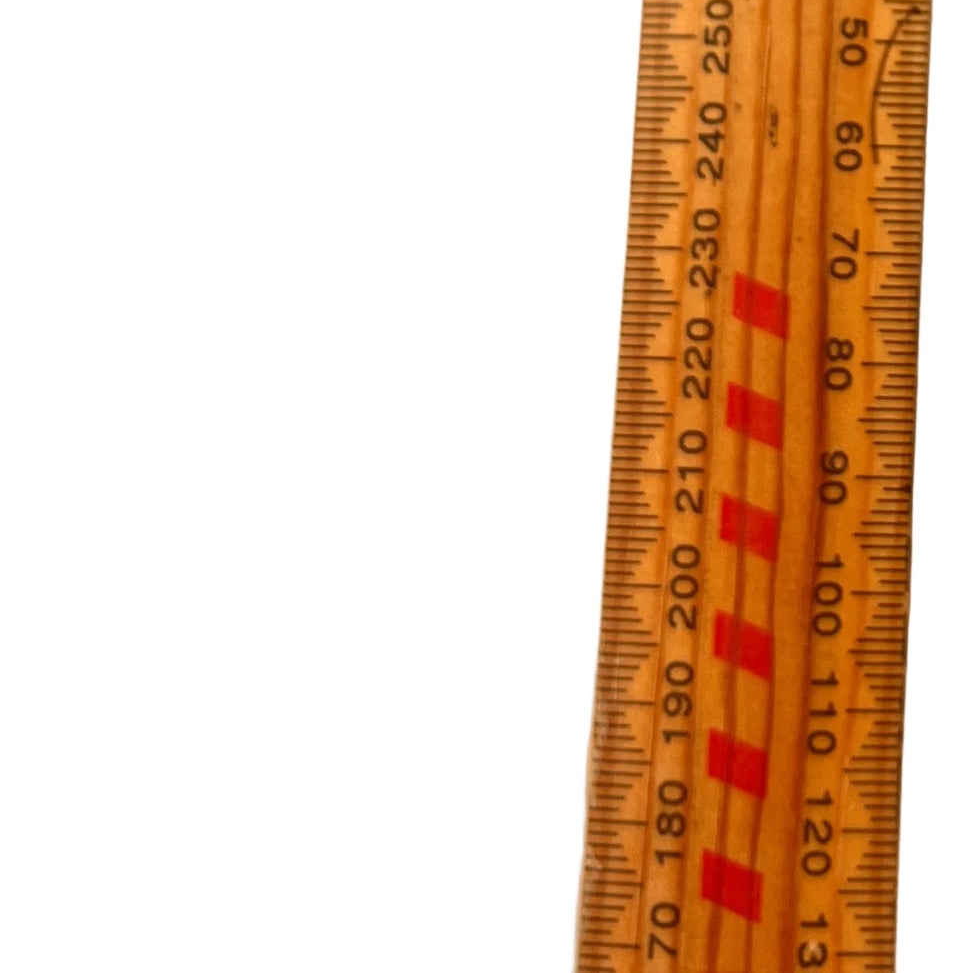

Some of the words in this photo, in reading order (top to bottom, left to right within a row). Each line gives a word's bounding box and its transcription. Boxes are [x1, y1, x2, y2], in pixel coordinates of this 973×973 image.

[839, 15, 868, 67] 50
[696, 99, 728, 182] 240
[834, 120, 863, 173] 60
[689, 207, 721, 290] 230
[829, 227, 860, 280] 70
[682, 316, 714, 401] 220
[823, 337, 854, 392] 80
[674, 428, 707, 515] 210
[817, 449, 849, 507] 90
[667, 543, 701, 631] 200
[811, 553, 845, 637] 100
[661, 660, 695, 745] 190
[806, 671, 838, 757] 110
[654, 778, 689, 864] 180
[801, 791, 833, 878] 120
[647, 901, 681, 960] 70
[797, 913, 829, 969] 13
